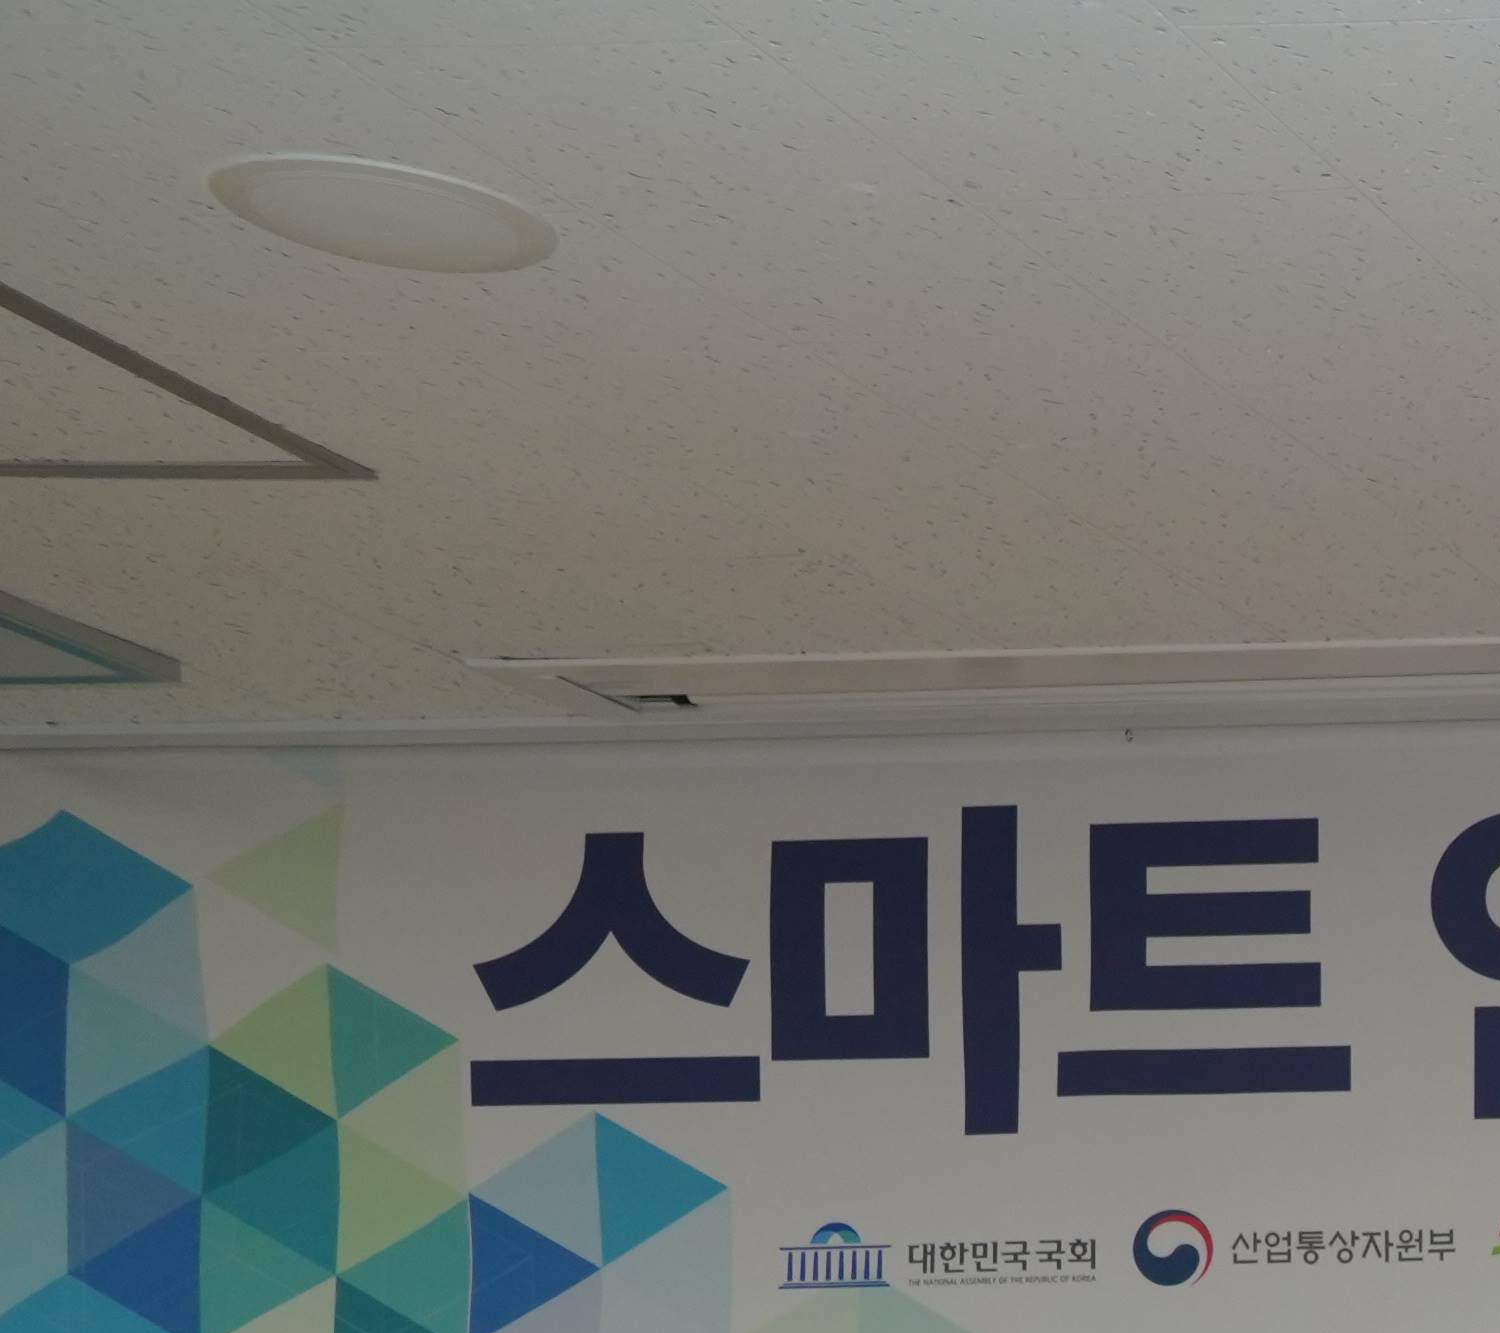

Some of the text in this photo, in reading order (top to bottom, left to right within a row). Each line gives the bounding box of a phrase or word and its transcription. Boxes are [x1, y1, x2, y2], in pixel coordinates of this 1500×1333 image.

[470, 805, 1351, 1135] 스마트
[907, 1238, 1096, 1274] 대한민국국회
[1231, 1229, 1456, 1265] 산업통상자원부
